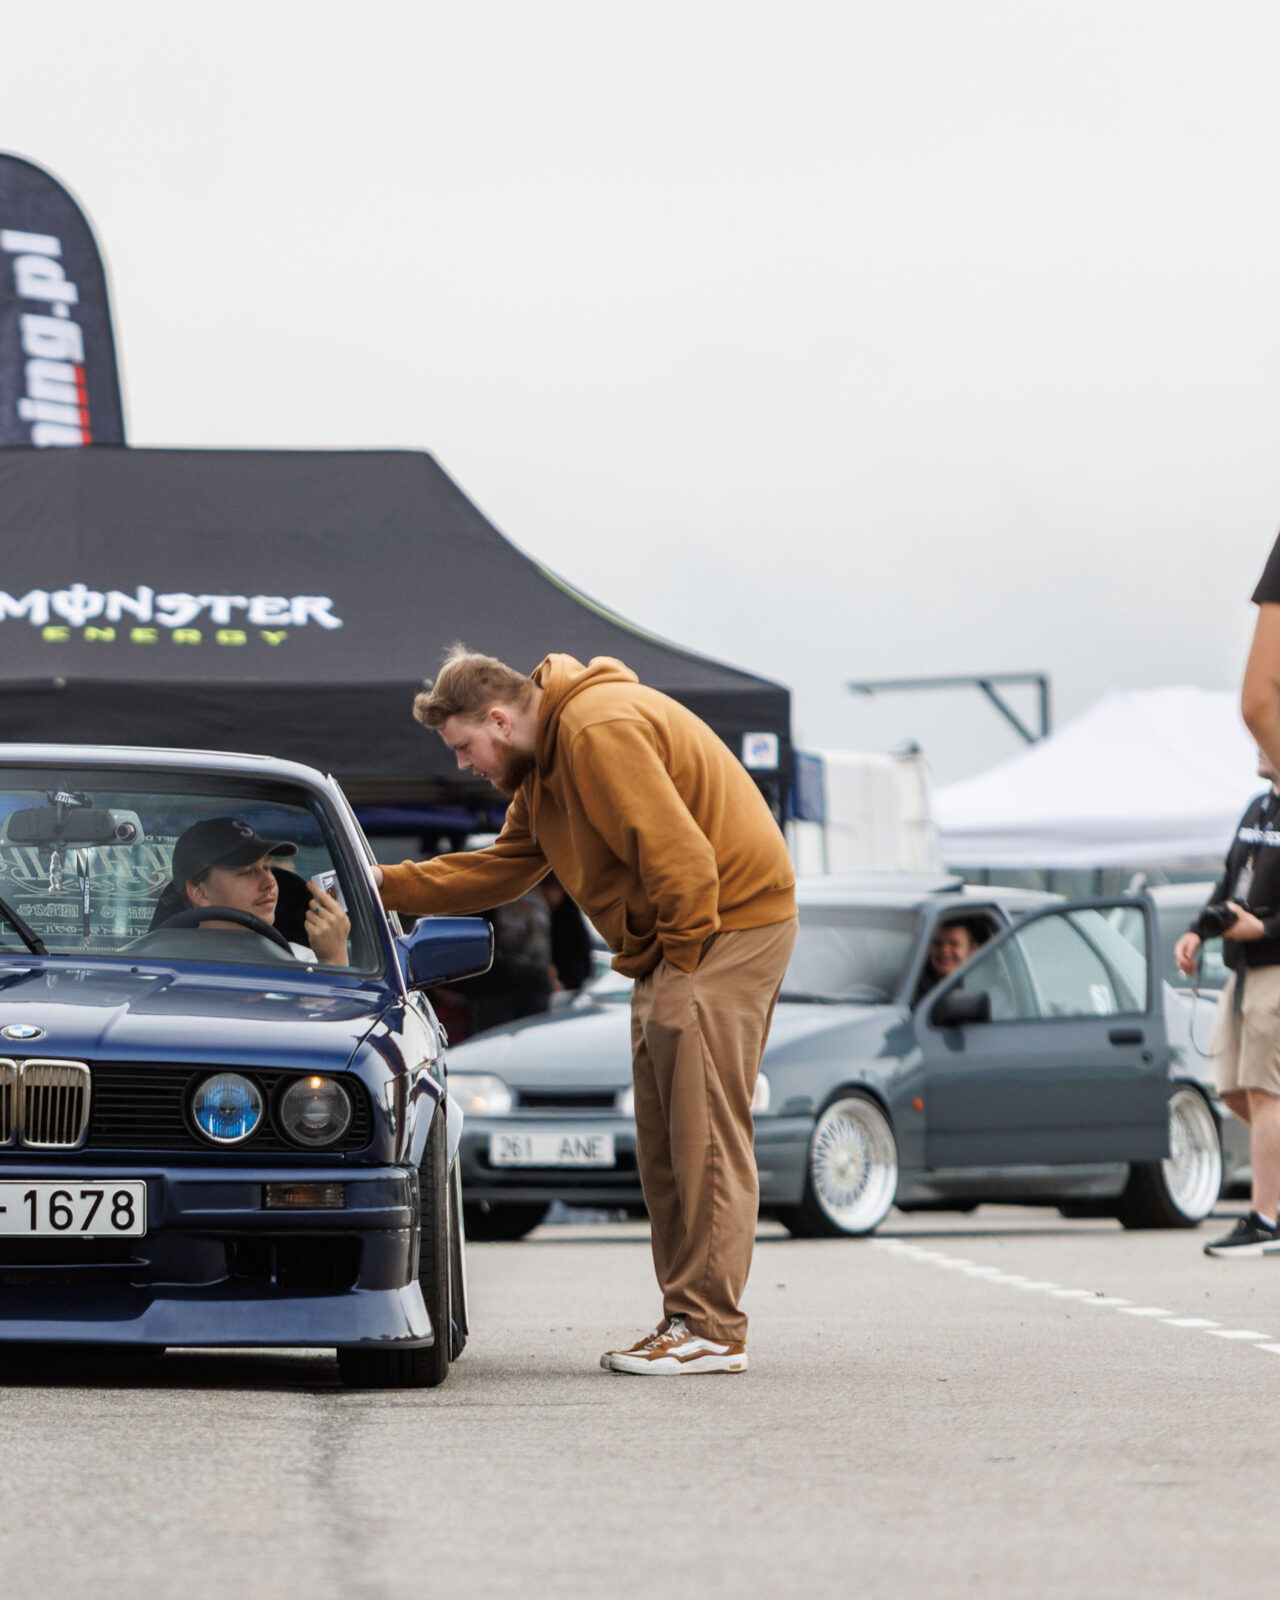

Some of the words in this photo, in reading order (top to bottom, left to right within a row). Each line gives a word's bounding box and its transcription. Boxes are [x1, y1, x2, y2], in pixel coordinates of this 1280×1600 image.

[42, 626, 288, 646] ENERGY
[497, 1135, 532, 1159] 261
[559, 1135, 605, 1159] ANE
